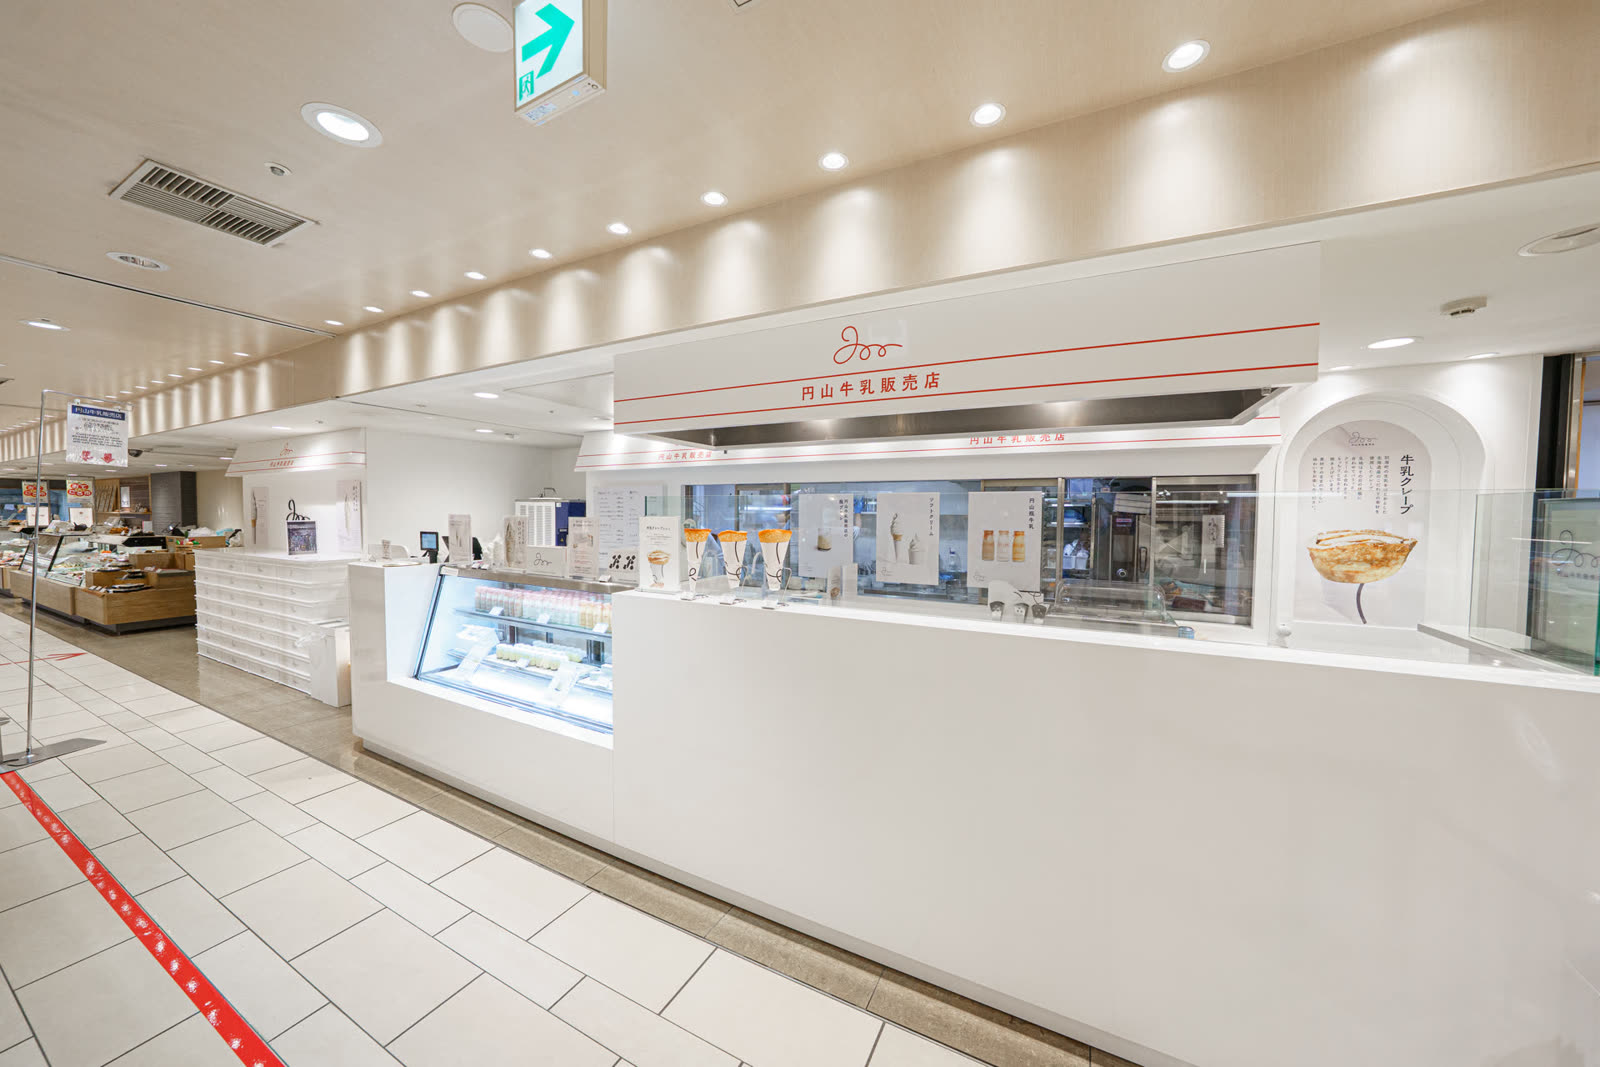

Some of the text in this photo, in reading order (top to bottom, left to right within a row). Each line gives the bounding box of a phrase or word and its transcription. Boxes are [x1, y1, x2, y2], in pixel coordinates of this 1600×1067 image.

[801, 371, 940, 401] 円山牛乳販売店
[1400, 454, 1414, 515] 牛乳クレープ
